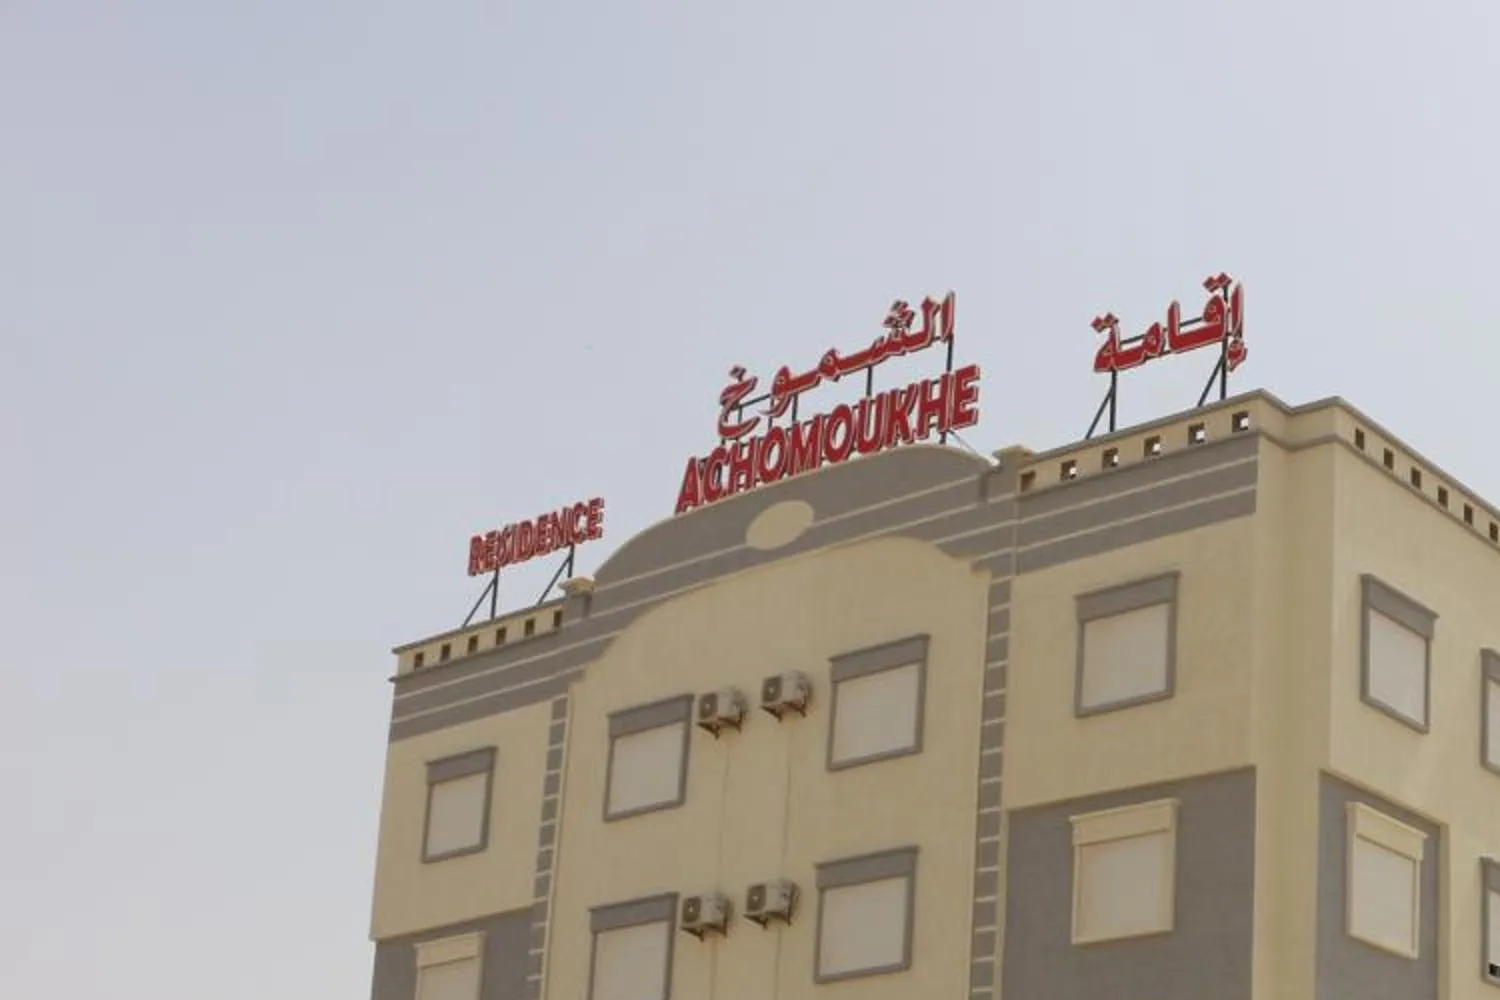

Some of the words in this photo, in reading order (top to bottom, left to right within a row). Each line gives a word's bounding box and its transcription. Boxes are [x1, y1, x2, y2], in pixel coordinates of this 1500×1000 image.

[718, 290, 955, 438] الشموخ
[1091, 272, 1248, 373] إقامة
[674, 364, 981, 514] ACHOMOUKHE
[468, 497, 605, 576] RESIDENCE
